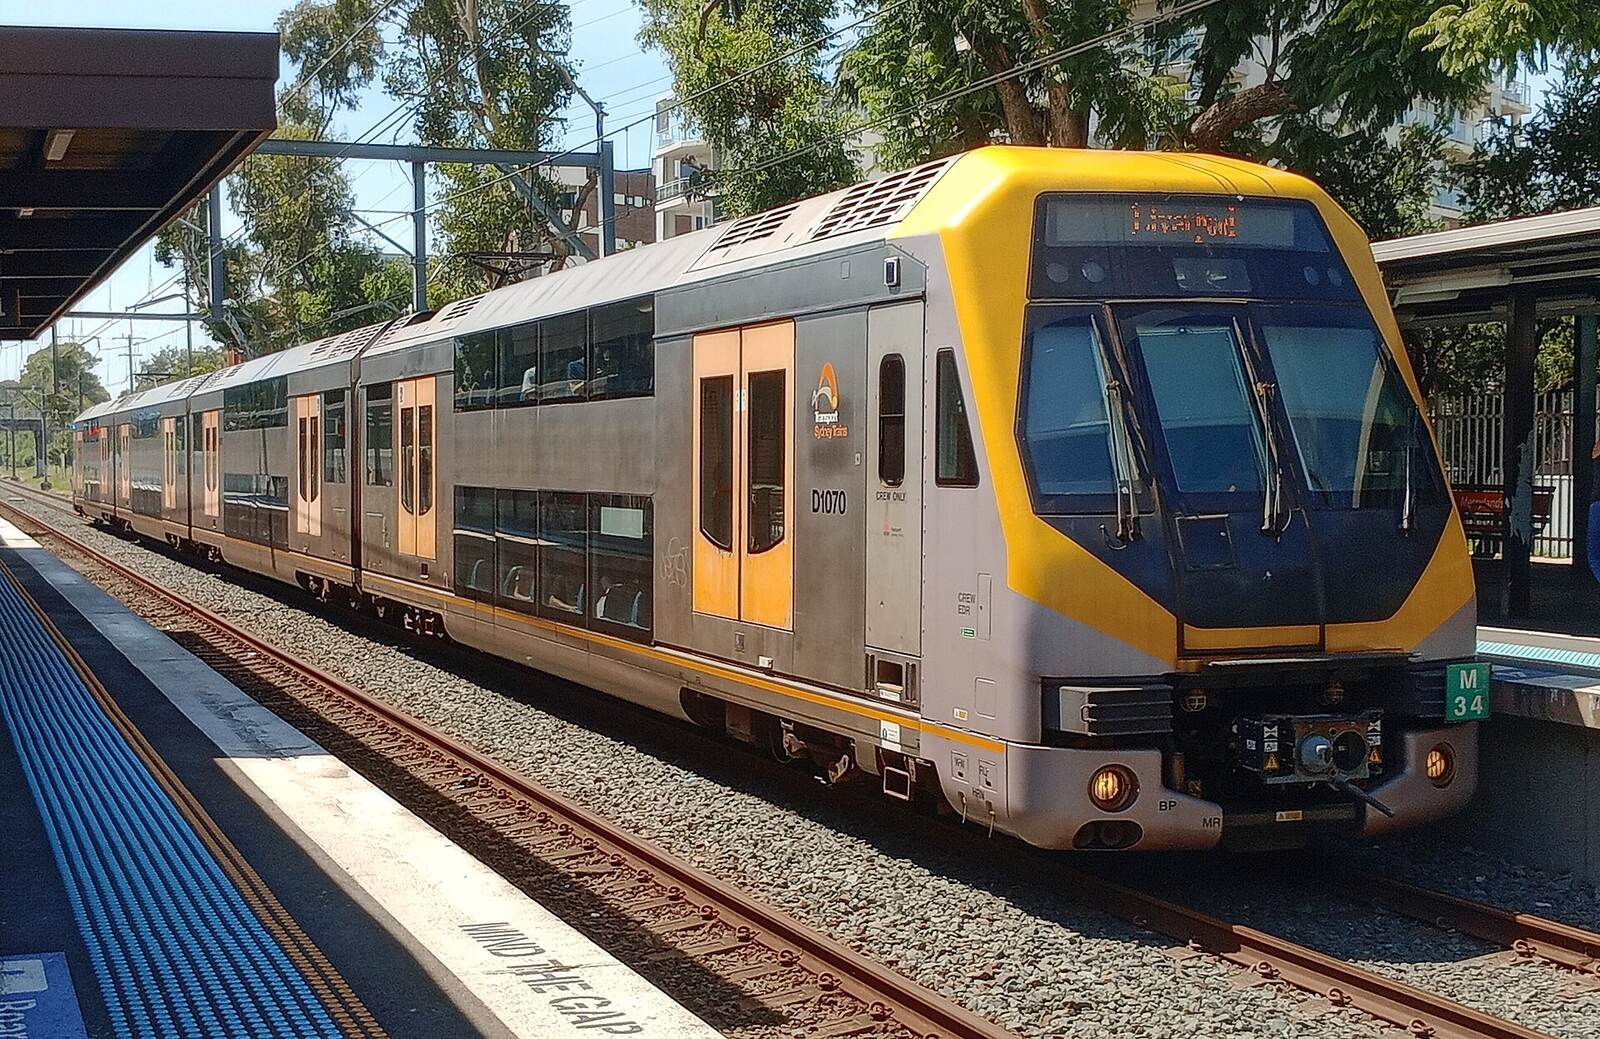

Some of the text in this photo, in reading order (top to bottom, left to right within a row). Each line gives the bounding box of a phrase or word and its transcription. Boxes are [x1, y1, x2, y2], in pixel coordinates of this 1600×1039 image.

[814, 410, 838, 425] Transport
[812, 489, 846, 514] D1070
[1460, 669, 1477, 689] M
[1159, 800, 1177, 811] BP
[1202, 817, 1221, 828] MR
[458, 922, 644, 1034] MIND THE GAP
